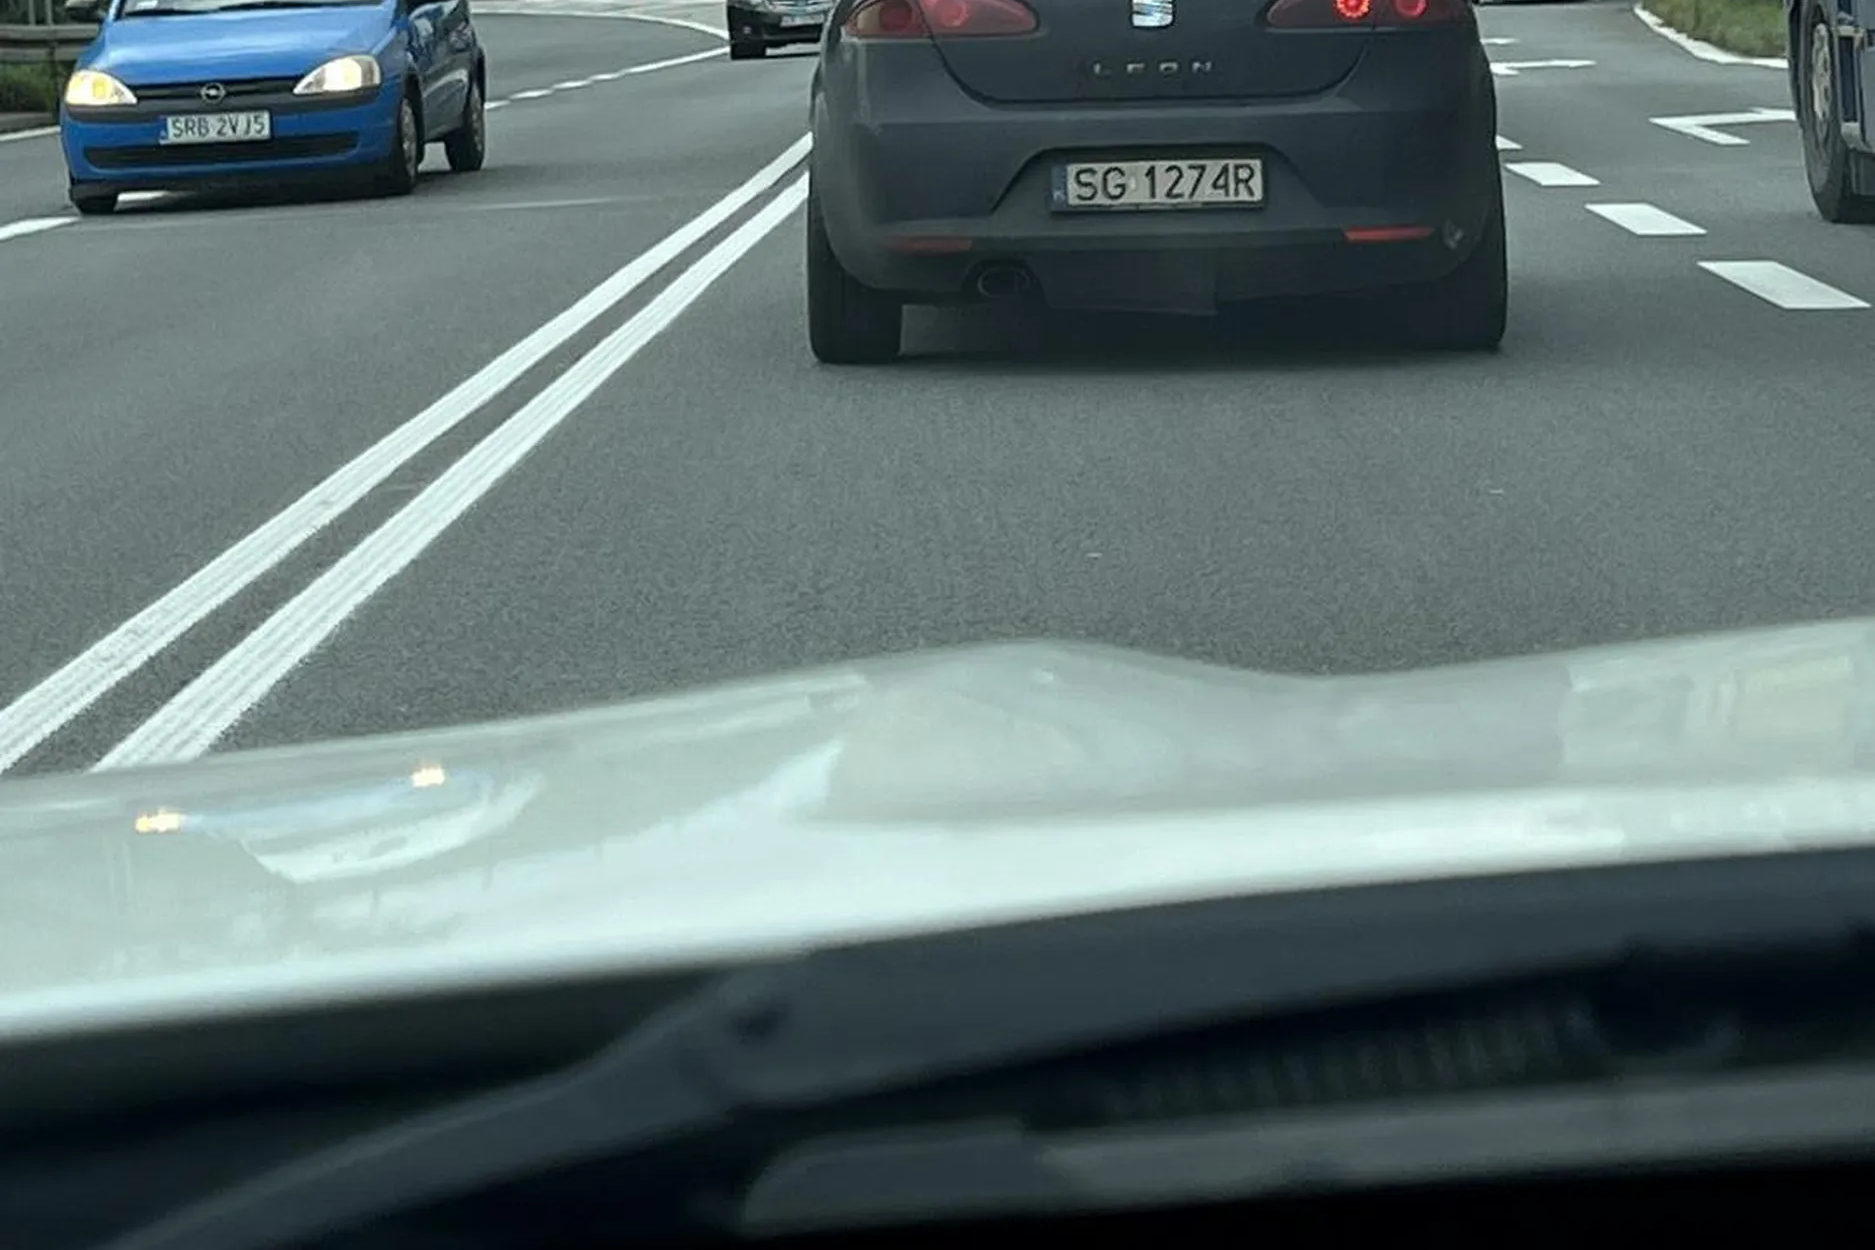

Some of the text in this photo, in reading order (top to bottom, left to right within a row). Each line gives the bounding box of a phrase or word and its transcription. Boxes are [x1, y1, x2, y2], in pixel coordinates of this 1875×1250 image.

[1093, 60, 1213, 76] LEON
[172, 116, 210, 138] SRB
[1074, 161, 1256, 202] SG 1274R
